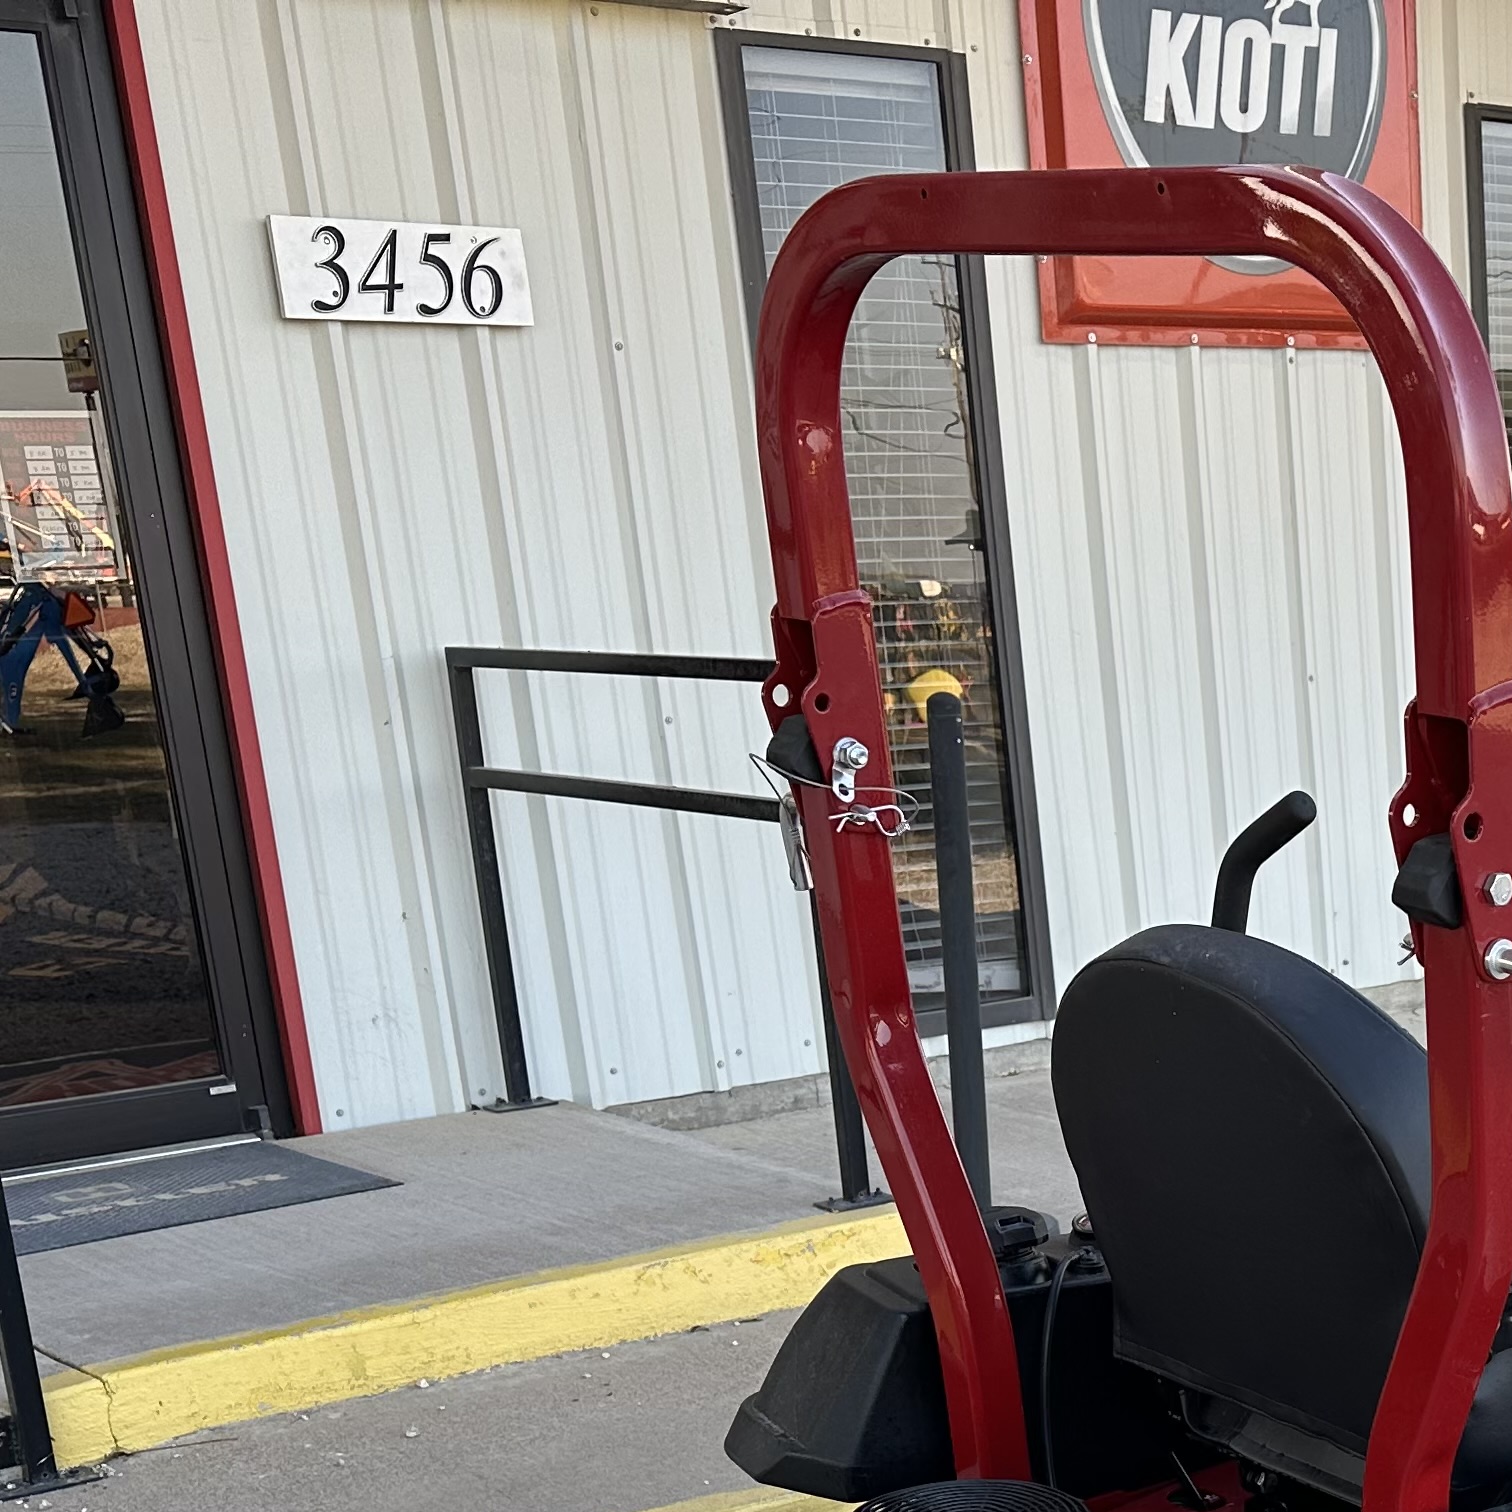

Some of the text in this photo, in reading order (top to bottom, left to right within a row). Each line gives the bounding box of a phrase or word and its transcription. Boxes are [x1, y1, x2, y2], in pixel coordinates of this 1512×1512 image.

[1144, 8, 1338, 137] KIOTI
[311, 225, 503, 319] 3456
[14, 432, 75, 442] HOURS
[54, 447, 65, 457] TO
[56, 462, 68, 472] TO
[59, 477, 70, 487] TO
